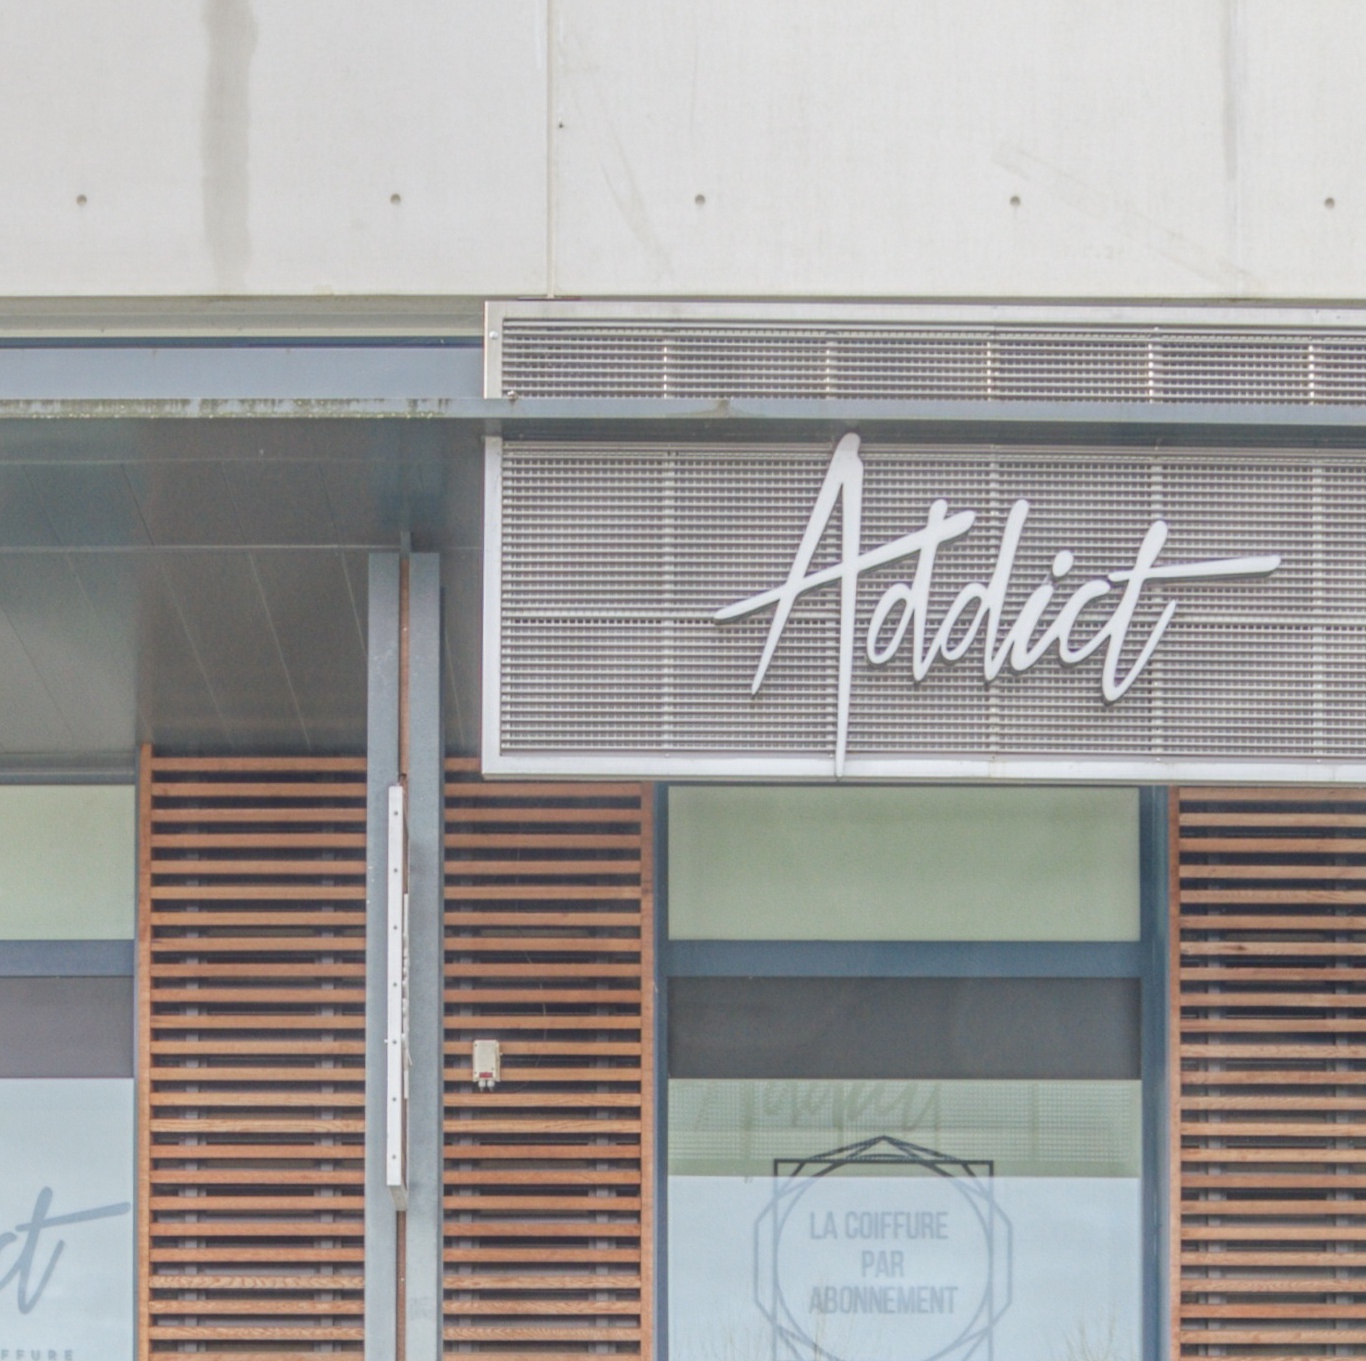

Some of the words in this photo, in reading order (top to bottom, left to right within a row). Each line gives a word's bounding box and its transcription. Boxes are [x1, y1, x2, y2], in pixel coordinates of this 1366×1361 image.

[713, 433, 1281, 777] Addict
[810, 1211, 837, 1240] LA
[845, 1211, 949, 1240] COIFFURE
[861, 1250, 905, 1278] PAR
[809, 1286, 959, 1314] ABONNEMENT
